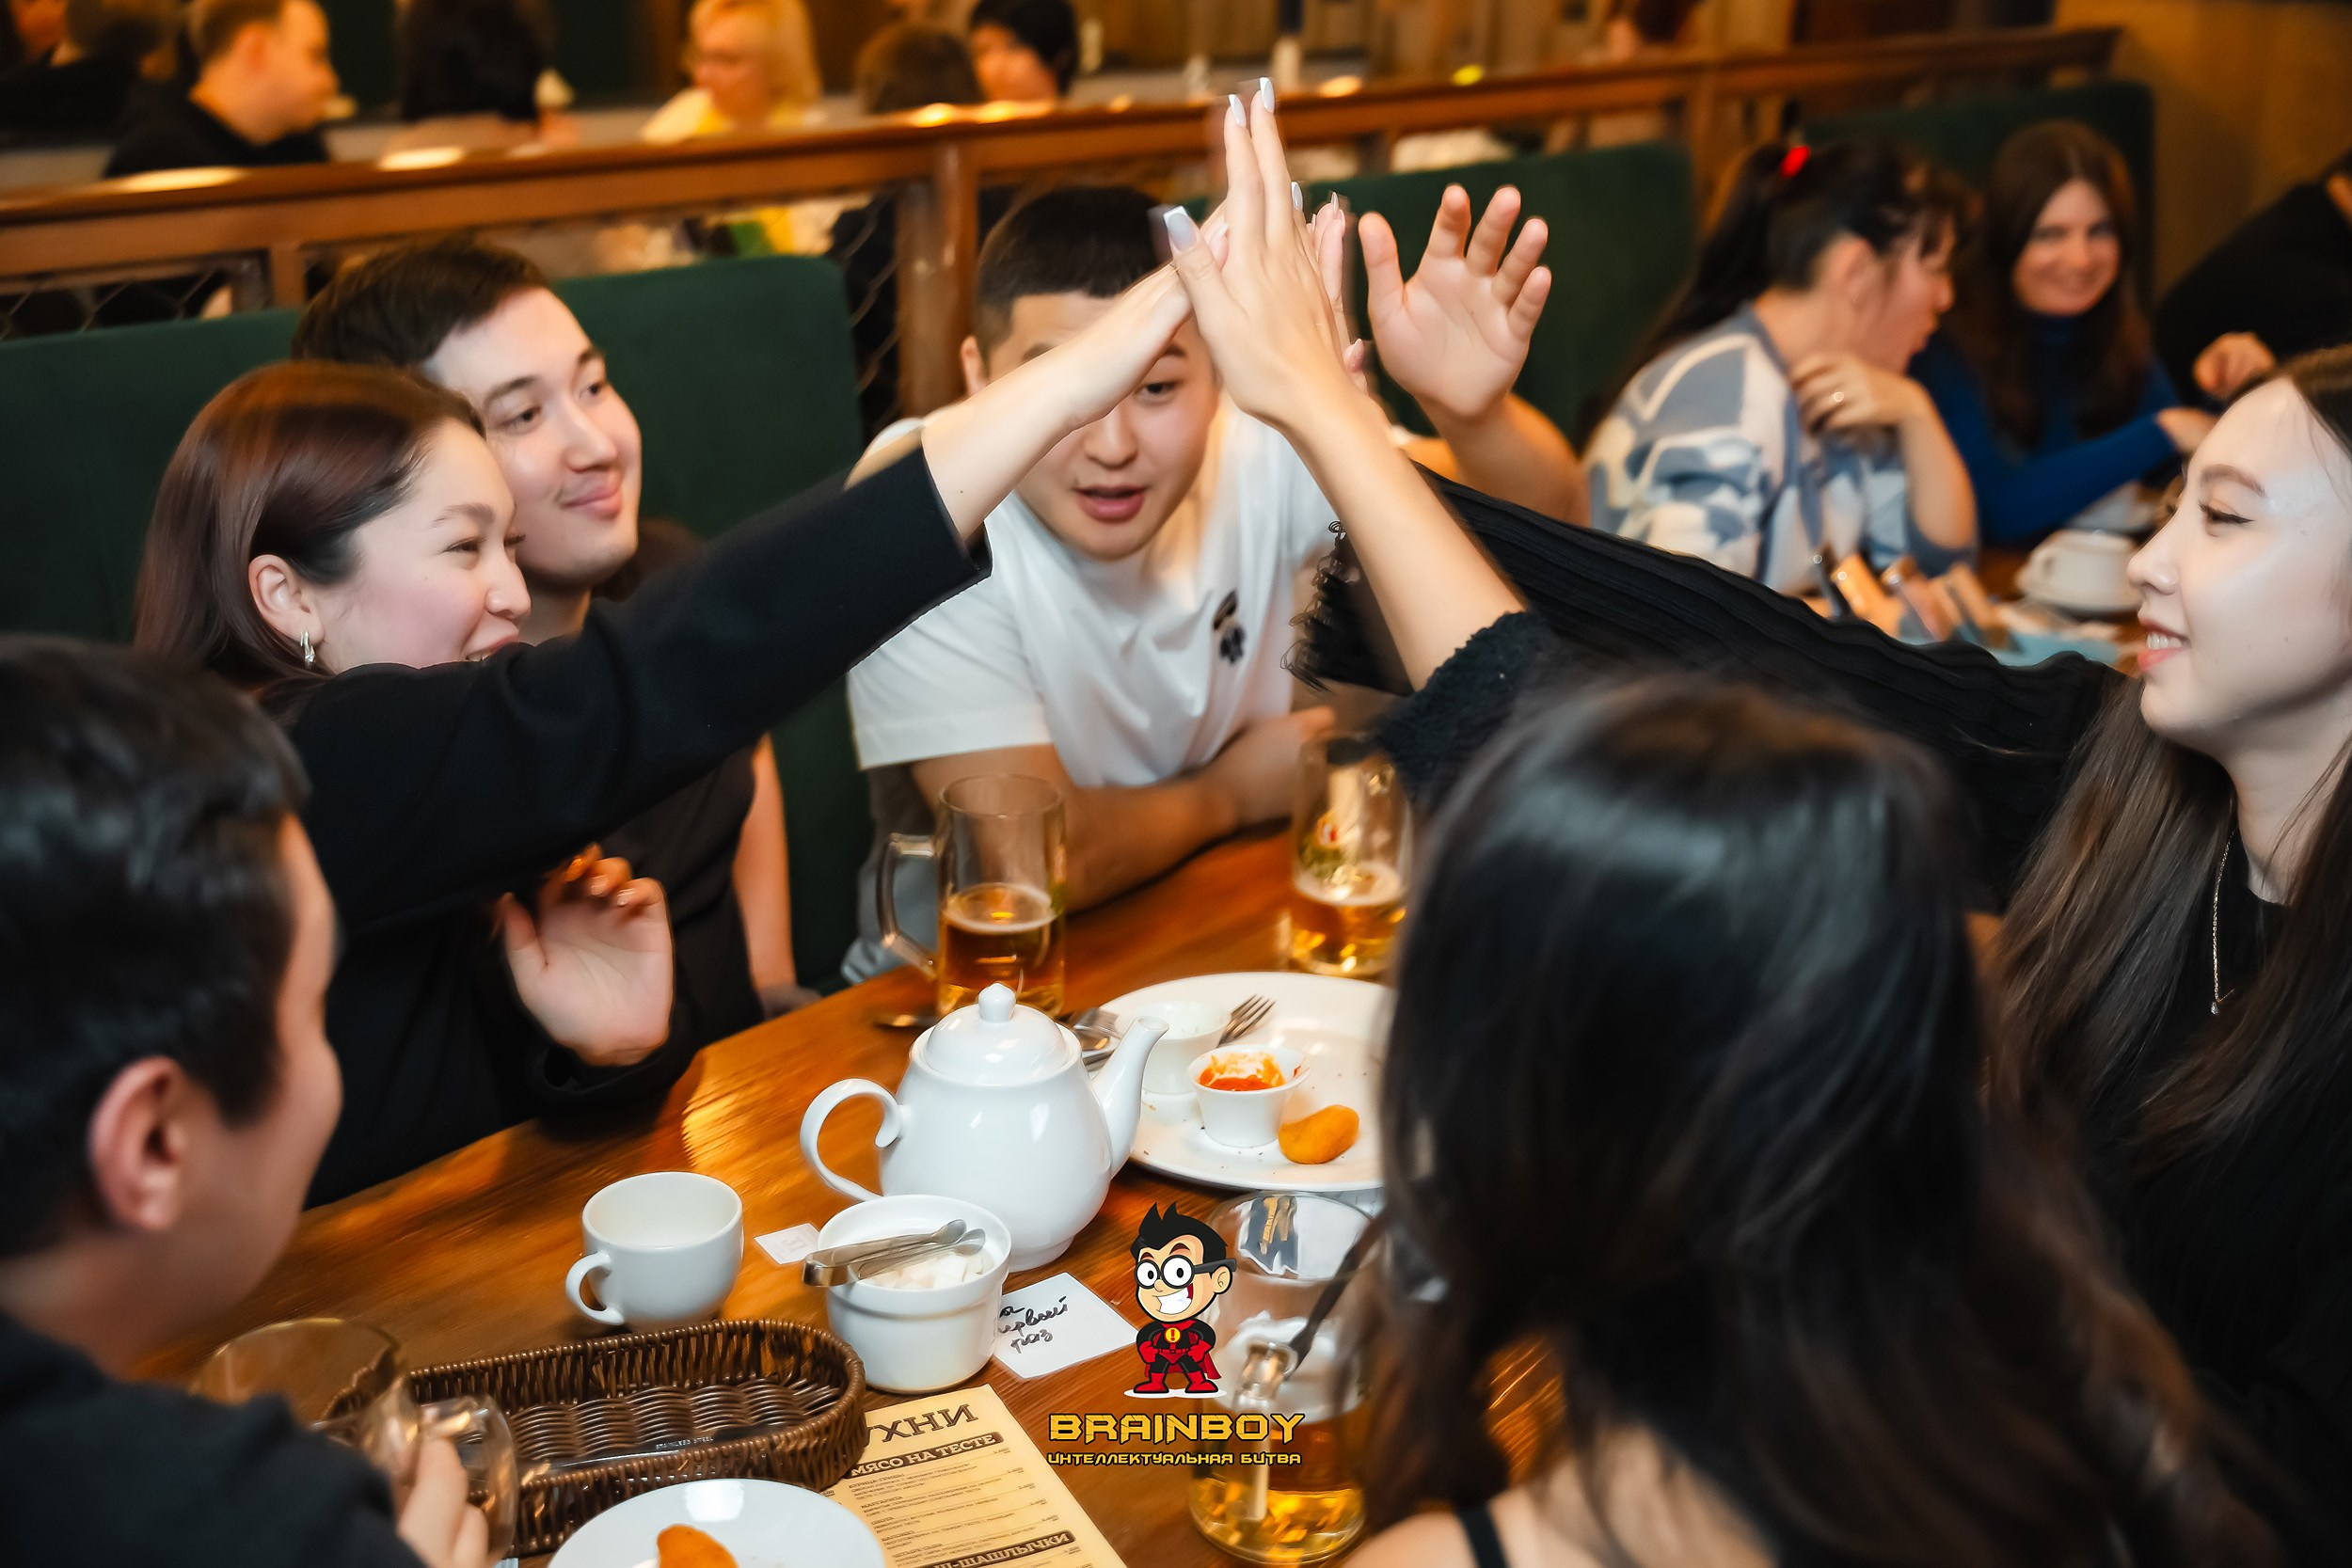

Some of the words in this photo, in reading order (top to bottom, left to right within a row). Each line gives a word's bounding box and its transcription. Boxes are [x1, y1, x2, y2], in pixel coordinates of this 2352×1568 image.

[1010, 1328, 1054, 1354] раз
[850, 1457, 905, 1478] МЯСО
[905, 1450, 938, 1465] НА
[939, 1433, 996, 1457] ТЕСТЕ
